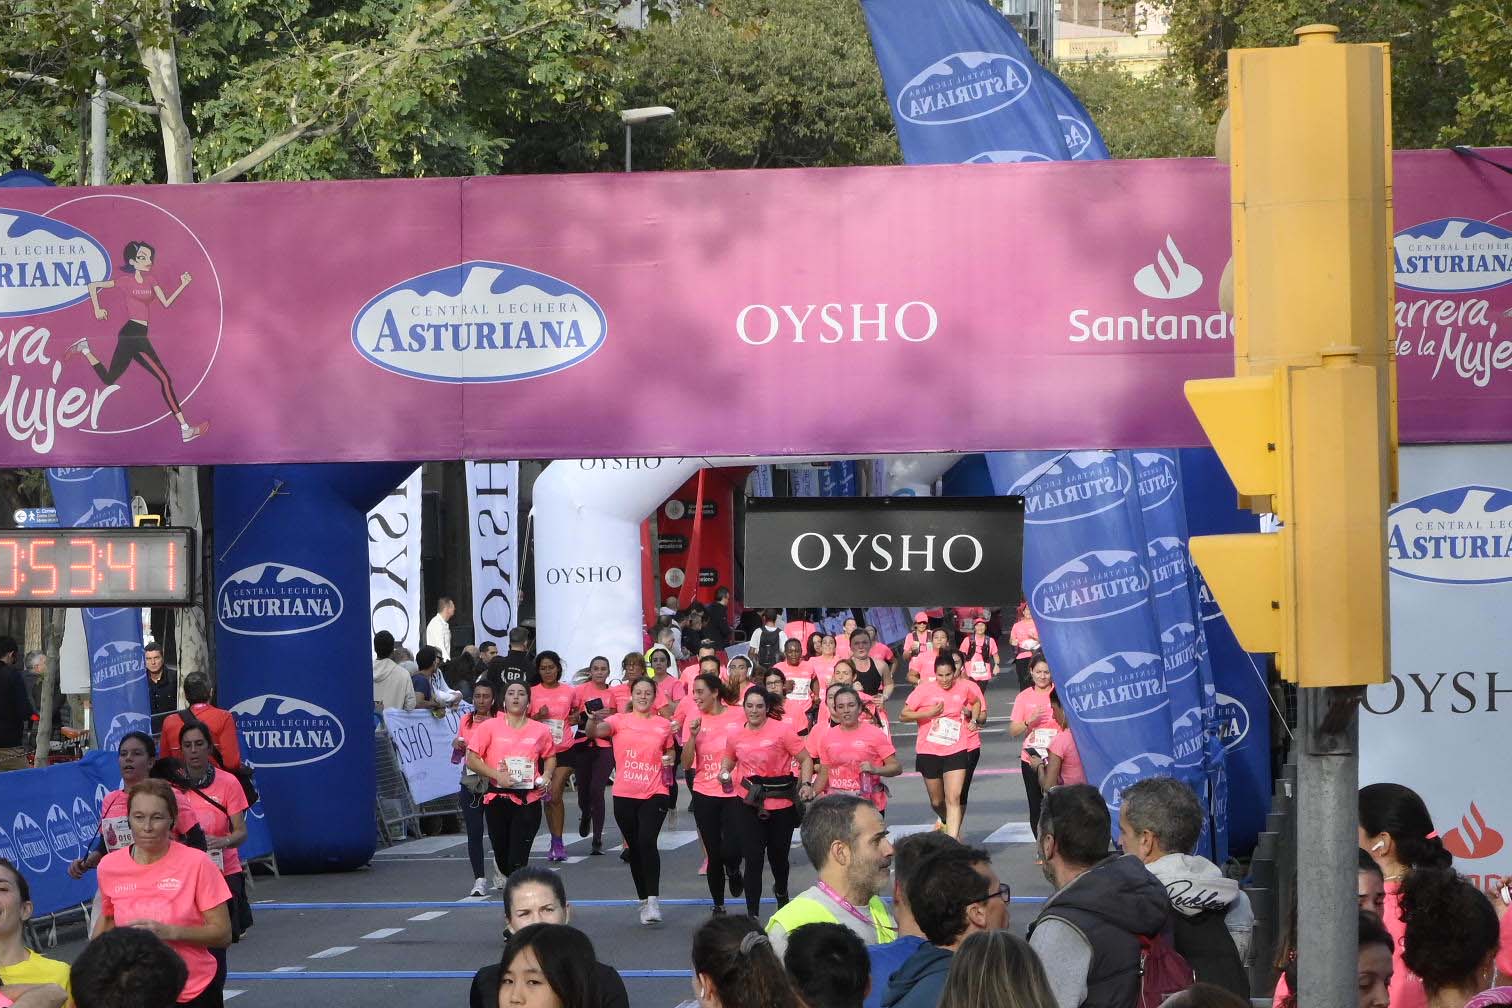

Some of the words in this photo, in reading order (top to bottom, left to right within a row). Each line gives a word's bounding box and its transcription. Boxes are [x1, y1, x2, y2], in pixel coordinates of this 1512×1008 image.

[15, 244, 86, 256] LECHERA
[411, 303, 489, 317] CENTRAL
[497, 301, 578, 314] LECHERA
[1395, 299, 1489, 327] arrera
[372, 309, 587, 352] ASTURIANA
[736, 301, 938, 345] OYSHO
[1069, 309, 1235, 342] Santand
[1418, 328, 1436, 356] la
[1431, 322, 1512, 387] Muje
[1415, 521, 1481, 531] CENTRAL
[1389, 524, 1512, 560] ASTURIA
[790, 531, 983, 574] OYSHO
[546, 565, 622, 585] OYSHO
[234, 587, 278, 596] CENTRAL
[281, 587, 330, 595] LECHERA
[221, 593, 334, 621] ASTURIANA
[507, 671, 520, 680] BP
[1361, 672, 1512, 716] OYSH
[283, 719, 330, 728] LECHERA
[243, 729, 334, 749] TURIANA
[626, 749, 636, 758] TU
[623, 770, 650, 782] SUMA
[624, 760, 660, 772] DORSAL
[832, 778, 860, 787] DORSA
[118, 834, 132, 842] 016
